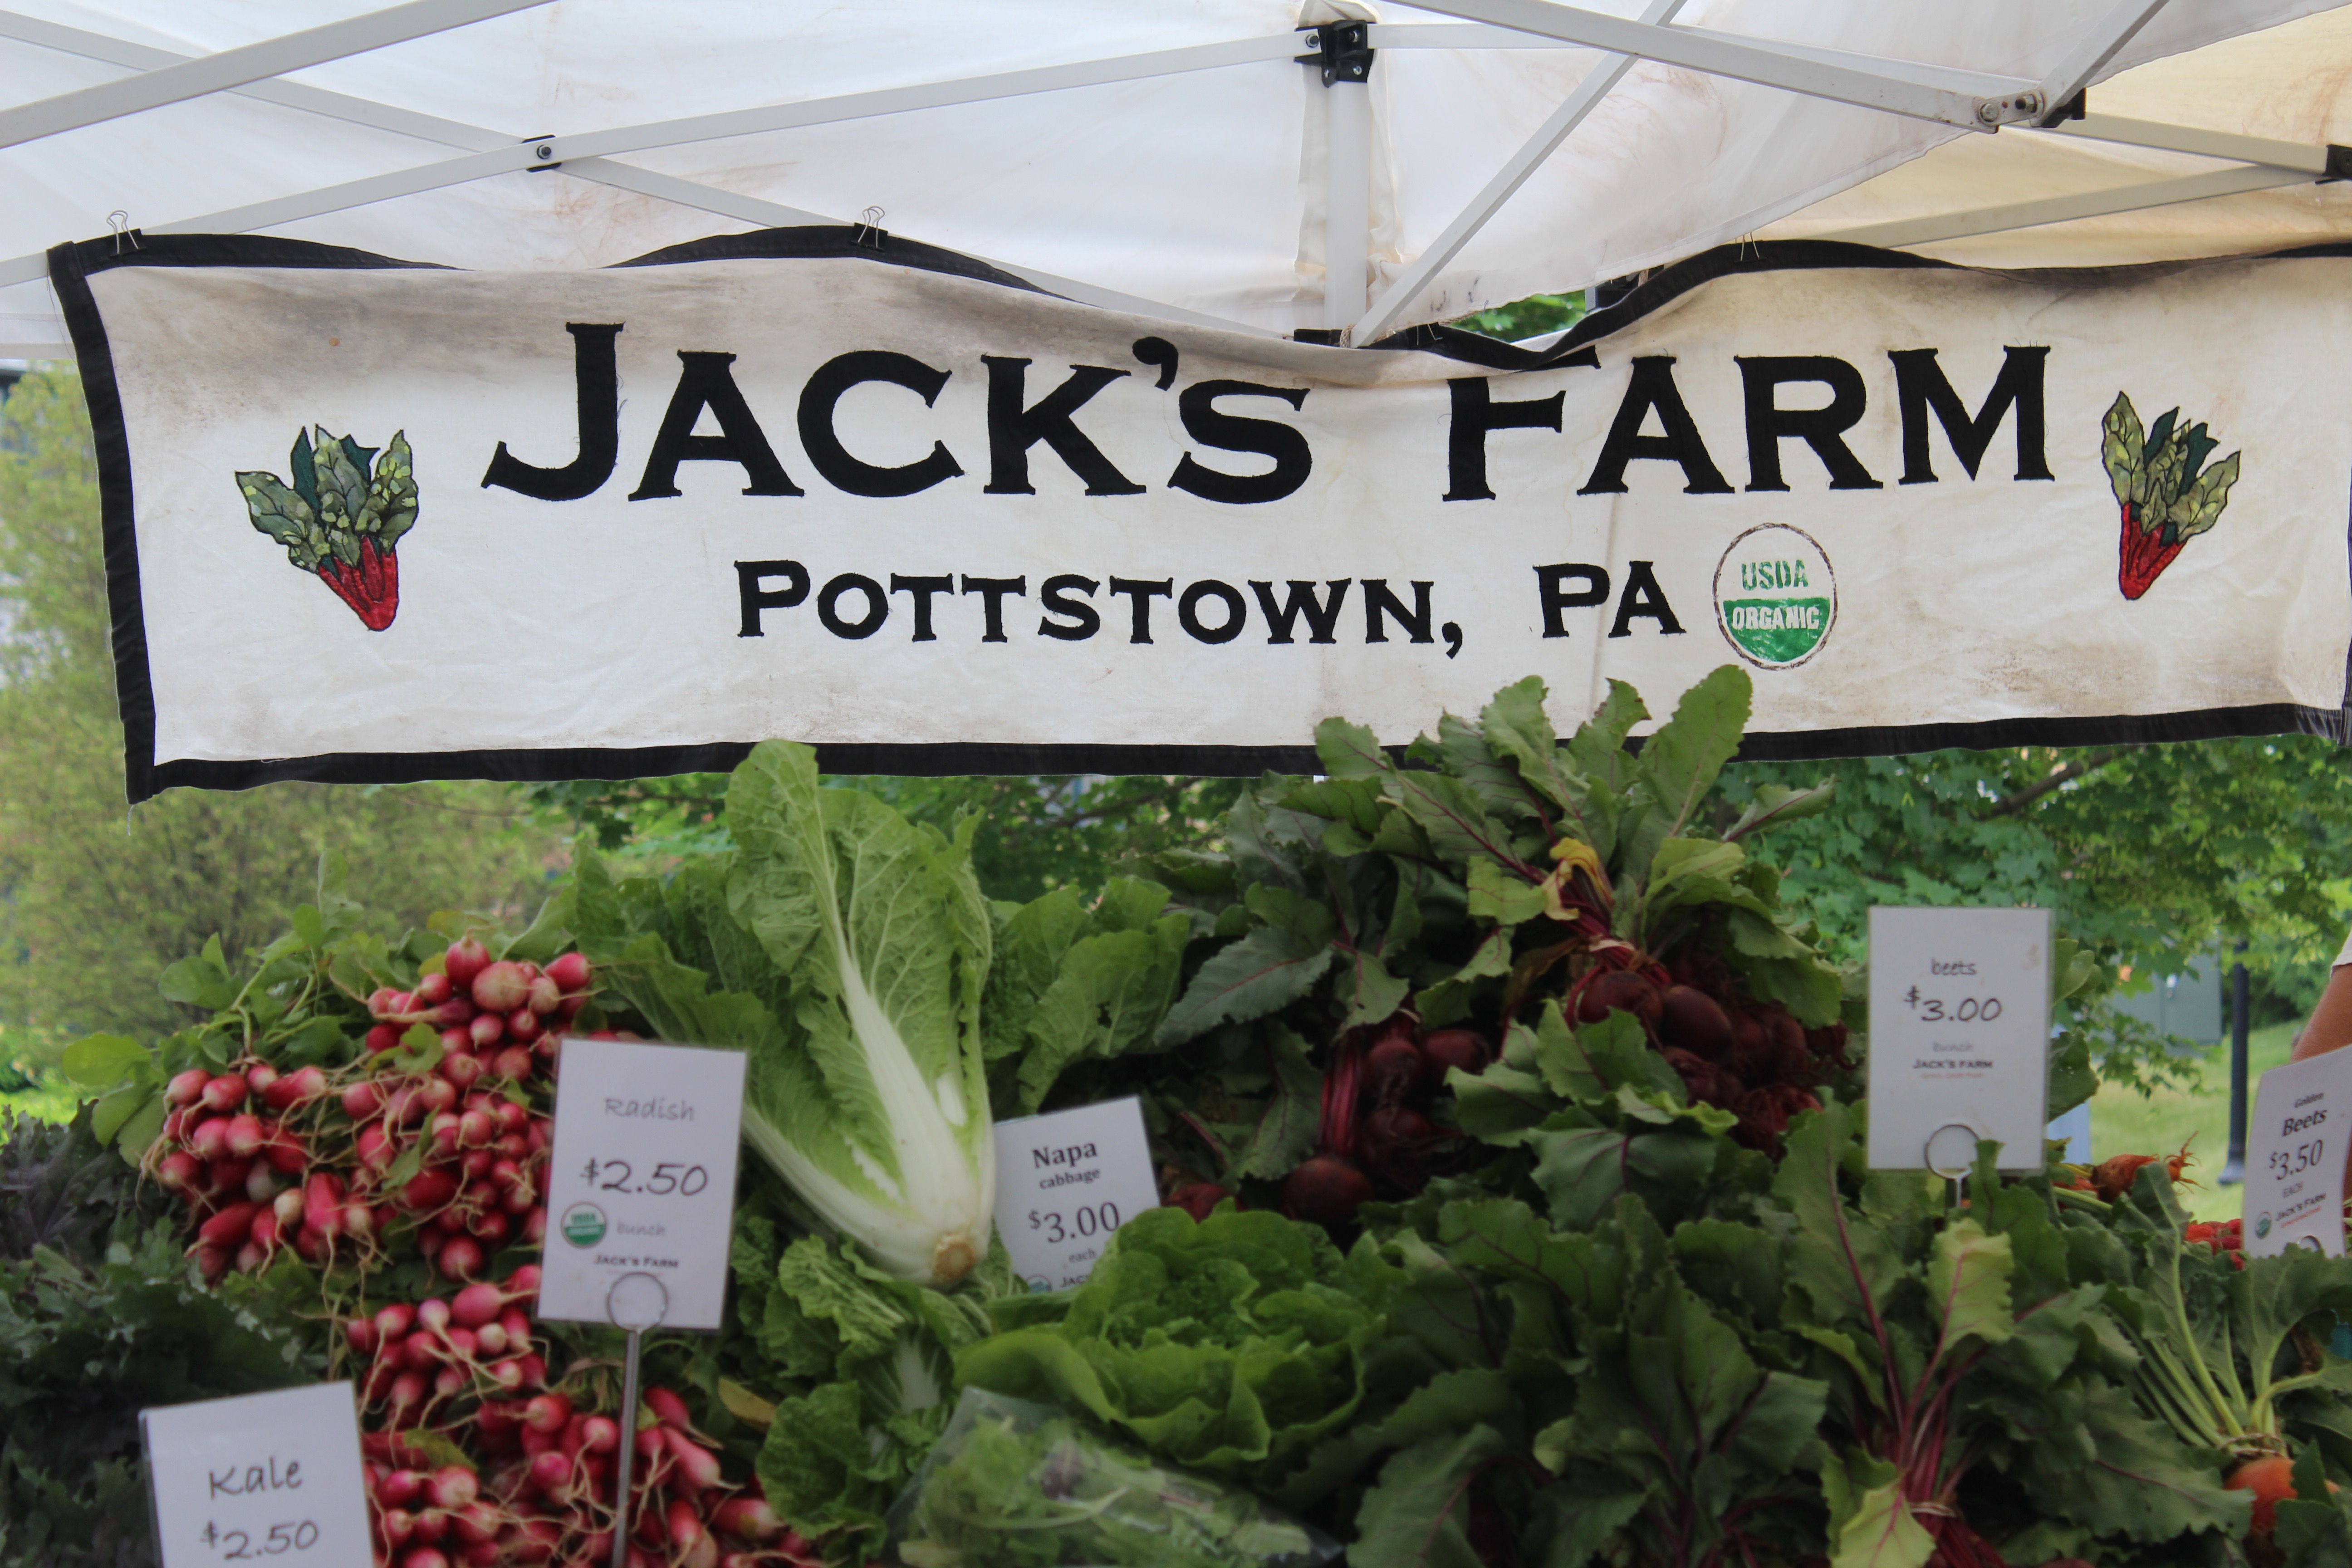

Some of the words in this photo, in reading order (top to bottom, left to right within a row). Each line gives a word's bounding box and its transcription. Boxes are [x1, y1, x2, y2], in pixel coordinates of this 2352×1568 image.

[481, 322, 1313, 504] JACK'S
[1442, 345, 2055, 502] FARM
[1741, 559, 1808, 591] USDA
[734, 560, 1463, 659] POTTSTOWN,
[1533, 561, 1686, 638] PA
[1732, 606, 1819, 630] ORGANIC
[1931, 957, 1977, 976] beets
[1903, 985, 2002, 1023] $3.00
[604, 1097, 694, 1122] Radish
[2282, 1109, 2328, 1137] Beets
[1031, 1142, 1098, 1169] Napa
[2269, 1139, 2323, 1180] $3.50
[580, 1158, 708, 1196] $2.50
[1039, 1168, 1101, 1190] cabbage
[1029, 1201, 1120, 1243] $3.00
[209, 1455, 303, 1501] Kale
[200, 1519, 319, 1560] $2.50
